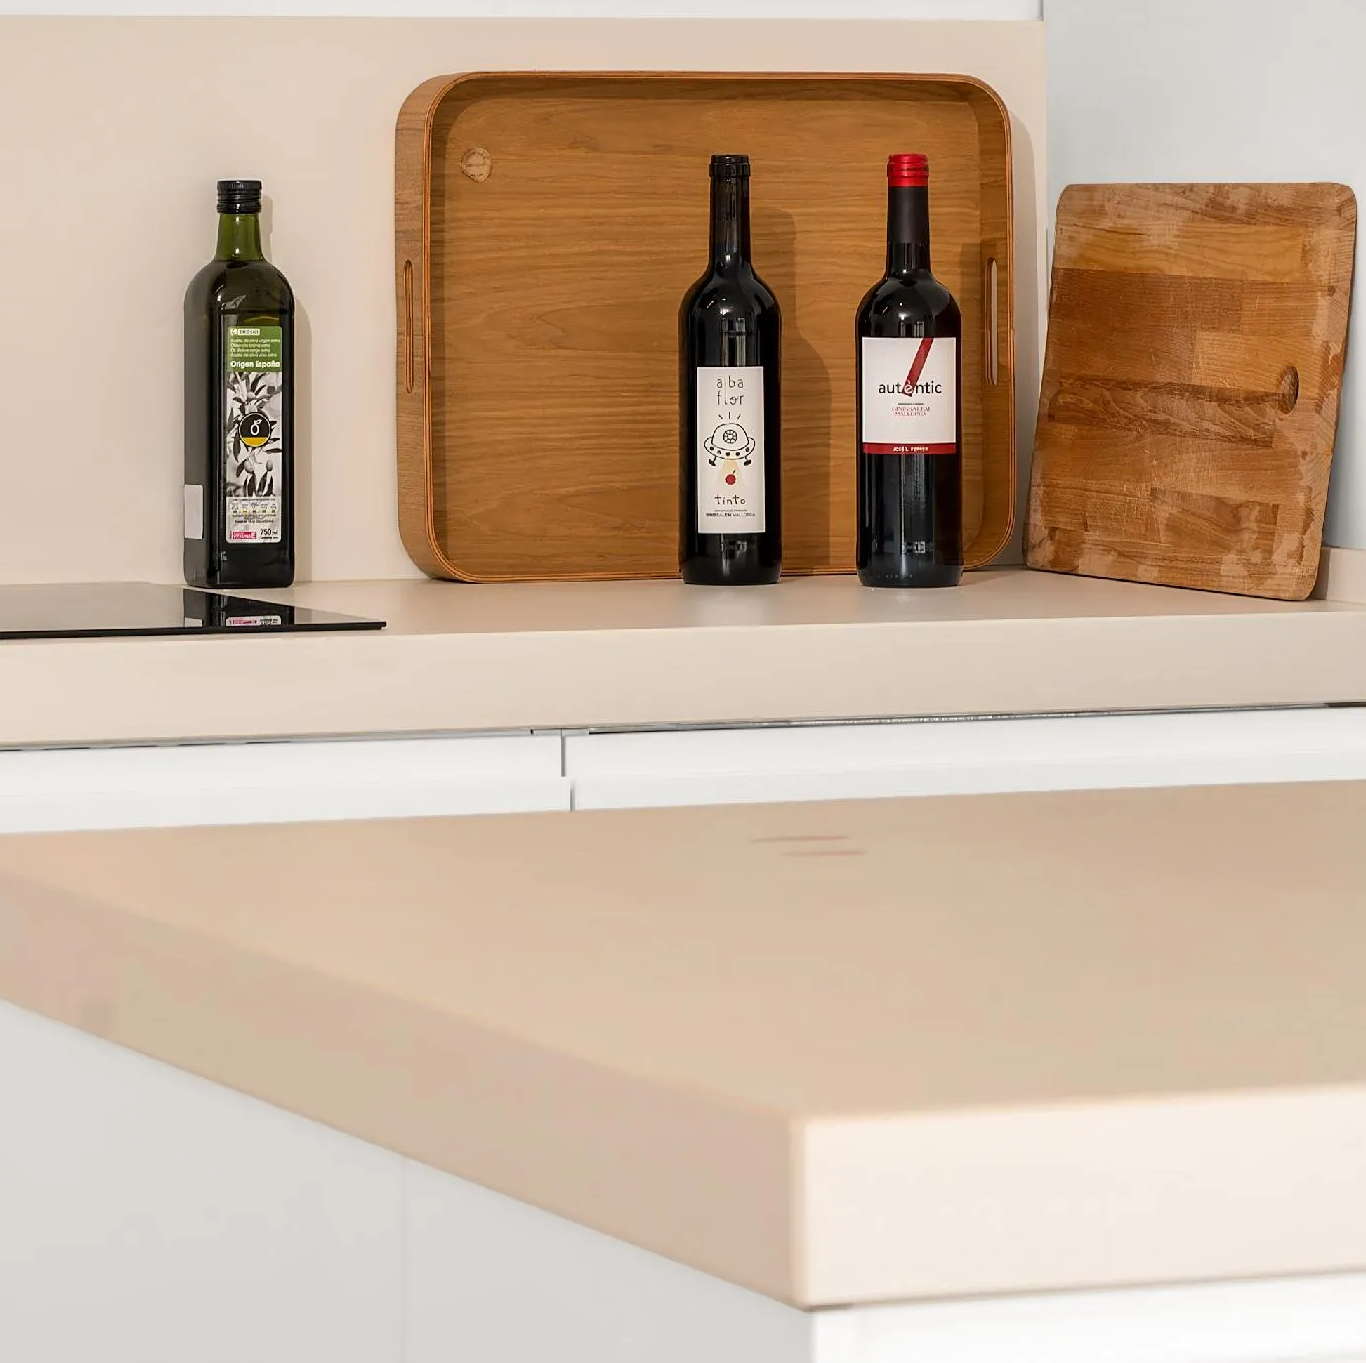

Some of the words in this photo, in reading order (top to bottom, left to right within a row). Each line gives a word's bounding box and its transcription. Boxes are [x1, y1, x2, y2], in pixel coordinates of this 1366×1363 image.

[230, 360, 254, 369] Origen
[255, 360, 280, 368] España
[716, 374, 744, 389] alba
[716, 390, 745, 406] flor
[714, 494, 746, 505] tinto
